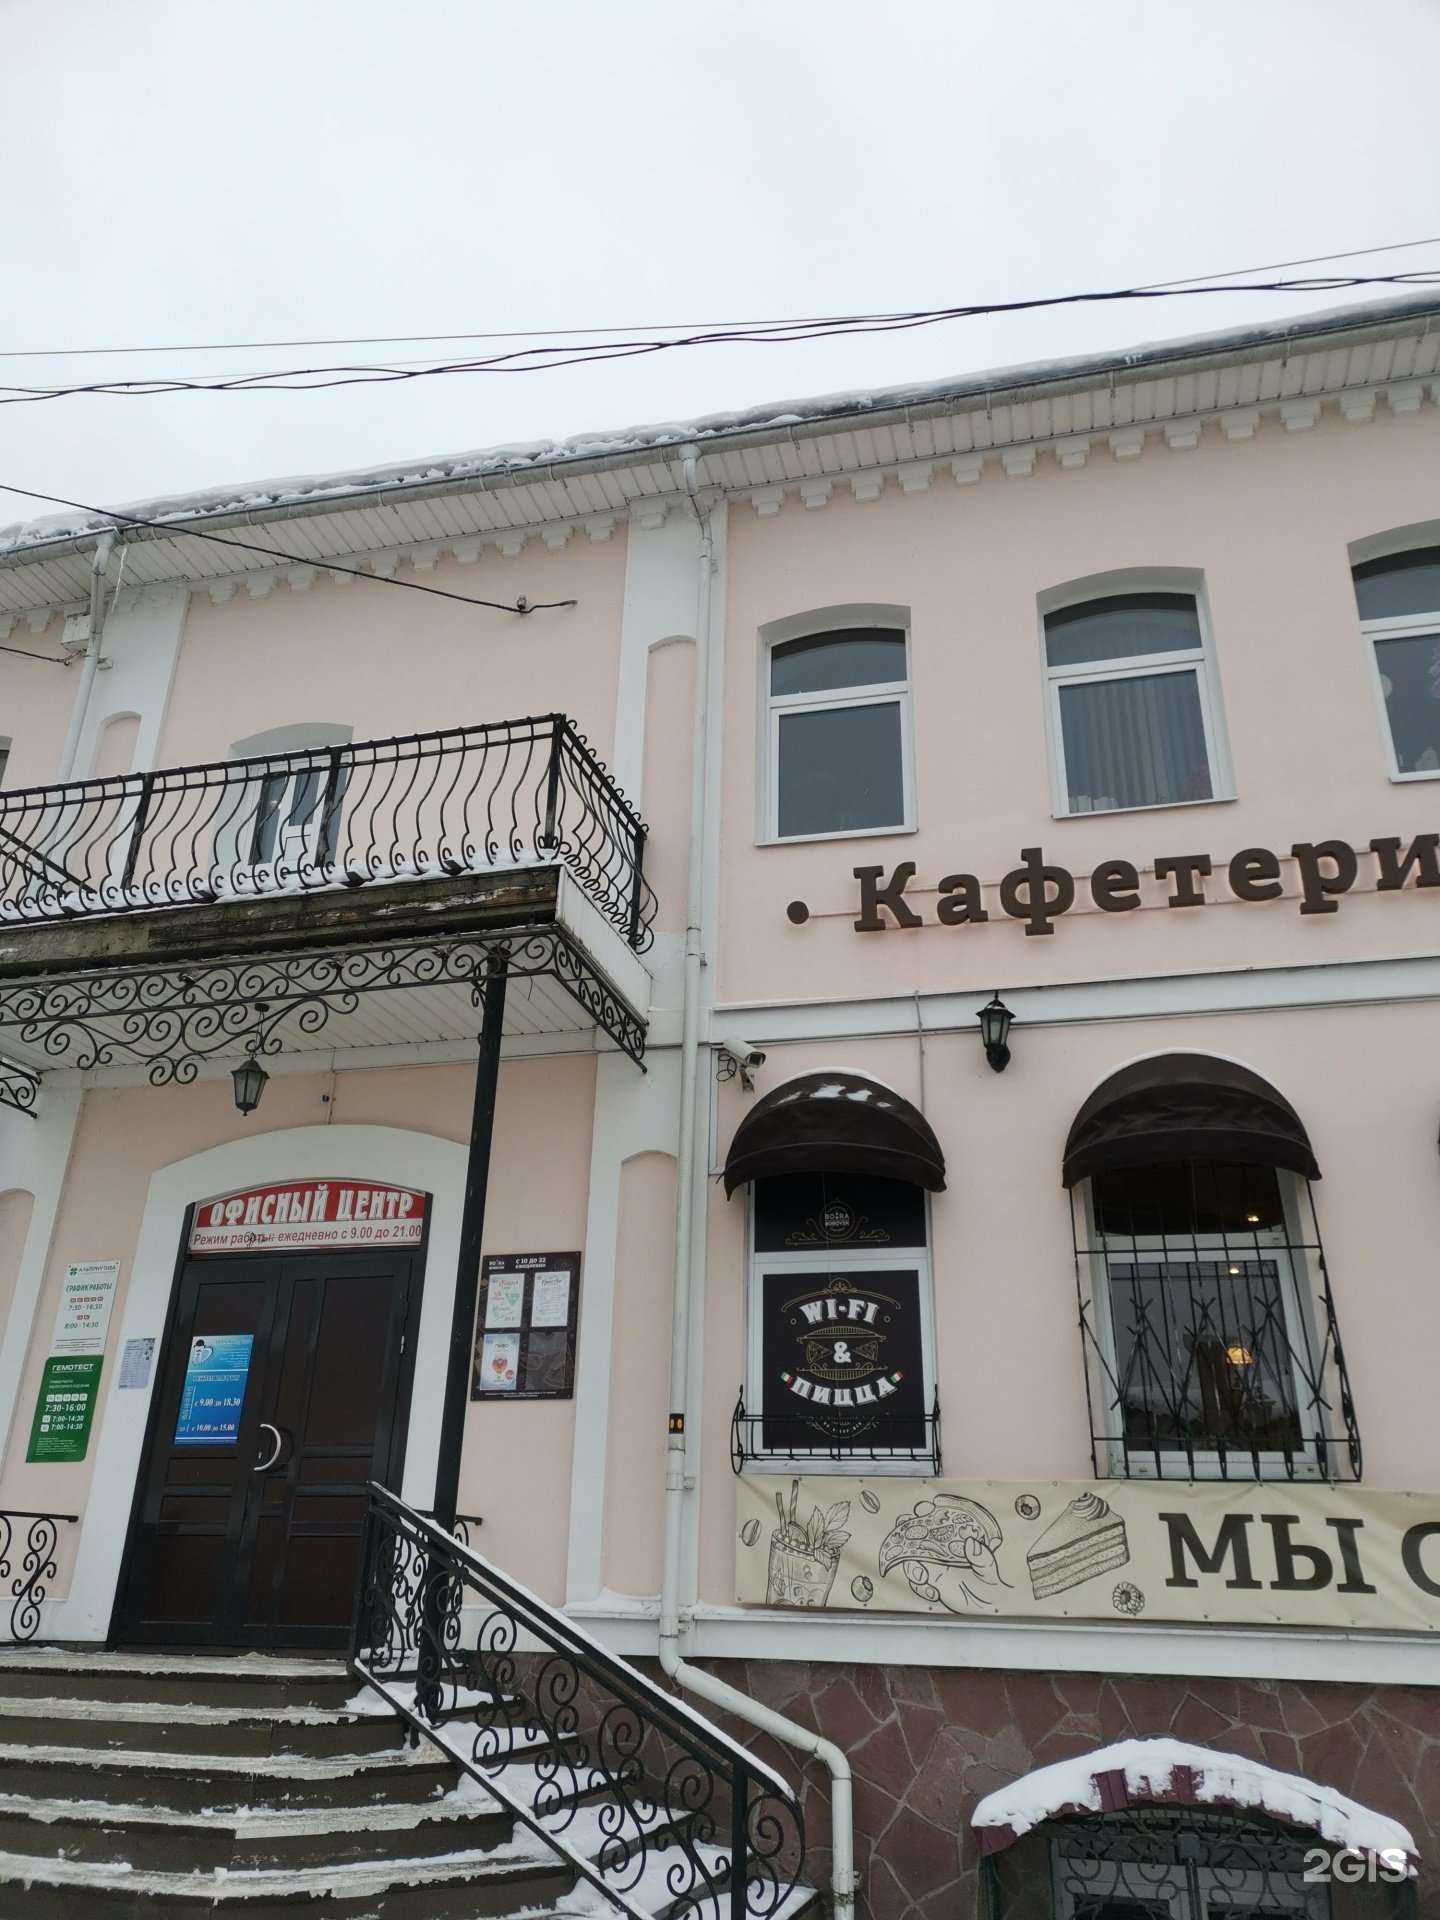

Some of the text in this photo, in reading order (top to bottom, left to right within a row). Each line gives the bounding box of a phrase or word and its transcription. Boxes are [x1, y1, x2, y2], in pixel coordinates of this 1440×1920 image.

[853, 833, 1440, 936] Кафетери
[209, 1183, 414, 1226] ОФИСНЫЙ ЦЕНТР
[193, 1233, 228, 1246] Режим
[278, 1230, 338, 1244] ежедневно
[341, 1231, 348, 1239] с
[350, 1226, 373, 1239] 9.00
[375, 1228, 389, 1241] до
[392, 1225, 422, 1238] 21.00
[89, 1282, 113, 1292] РАБОТЫ
[799, 1298, 880, 1325] WI-FI
[833, 1341, 851, 1363] &
[52, 1363, 95, 1372] ГЕМОТЕСТ
[789, 1376, 898, 1408] ПИЦЦА
[1157, 1511, 1377, 1596] МЫ
